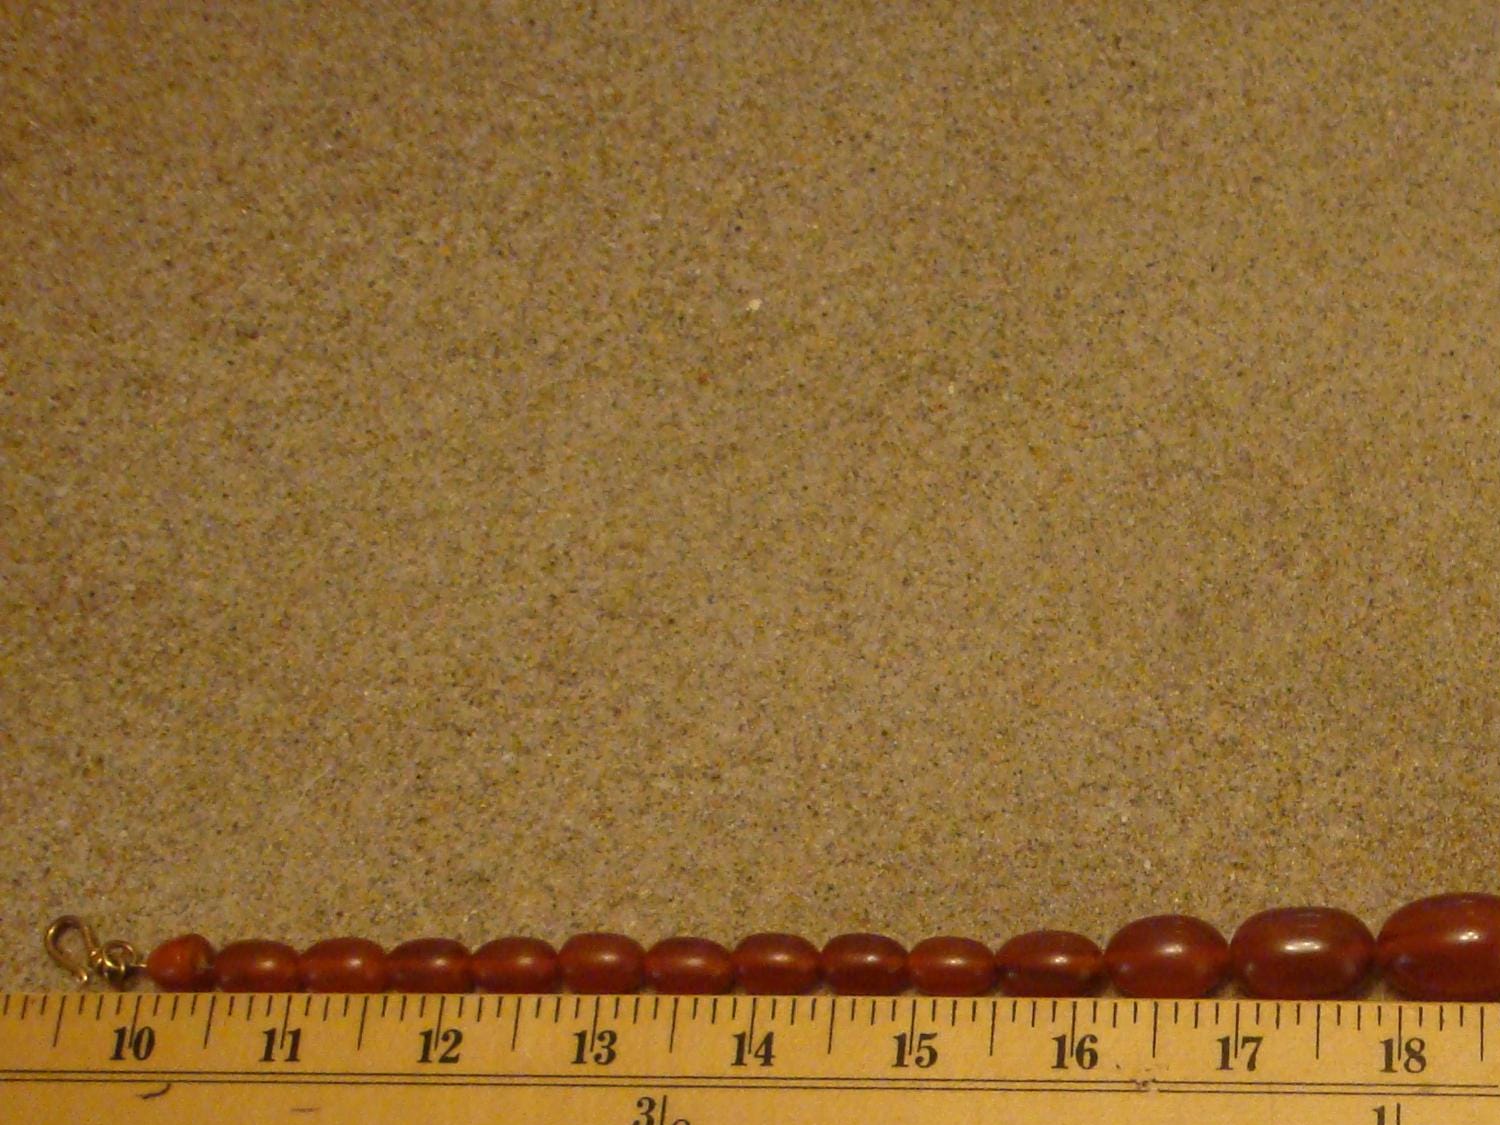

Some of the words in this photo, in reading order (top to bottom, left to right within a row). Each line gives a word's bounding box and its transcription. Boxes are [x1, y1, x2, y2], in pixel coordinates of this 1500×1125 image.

[109, 1026, 157, 1062] 10
[258, 1028, 302, 1063] 11
[417, 1029, 461, 1064] 12
[572, 1029, 618, 1065] 13
[731, 1032, 776, 1068] 14
[892, 1033, 939, 1069] 15
[1052, 1034, 1099, 1071] 16
[1217, 1035, 1264, 1071] 17
[1379, 1036, 1427, 1073] 18
